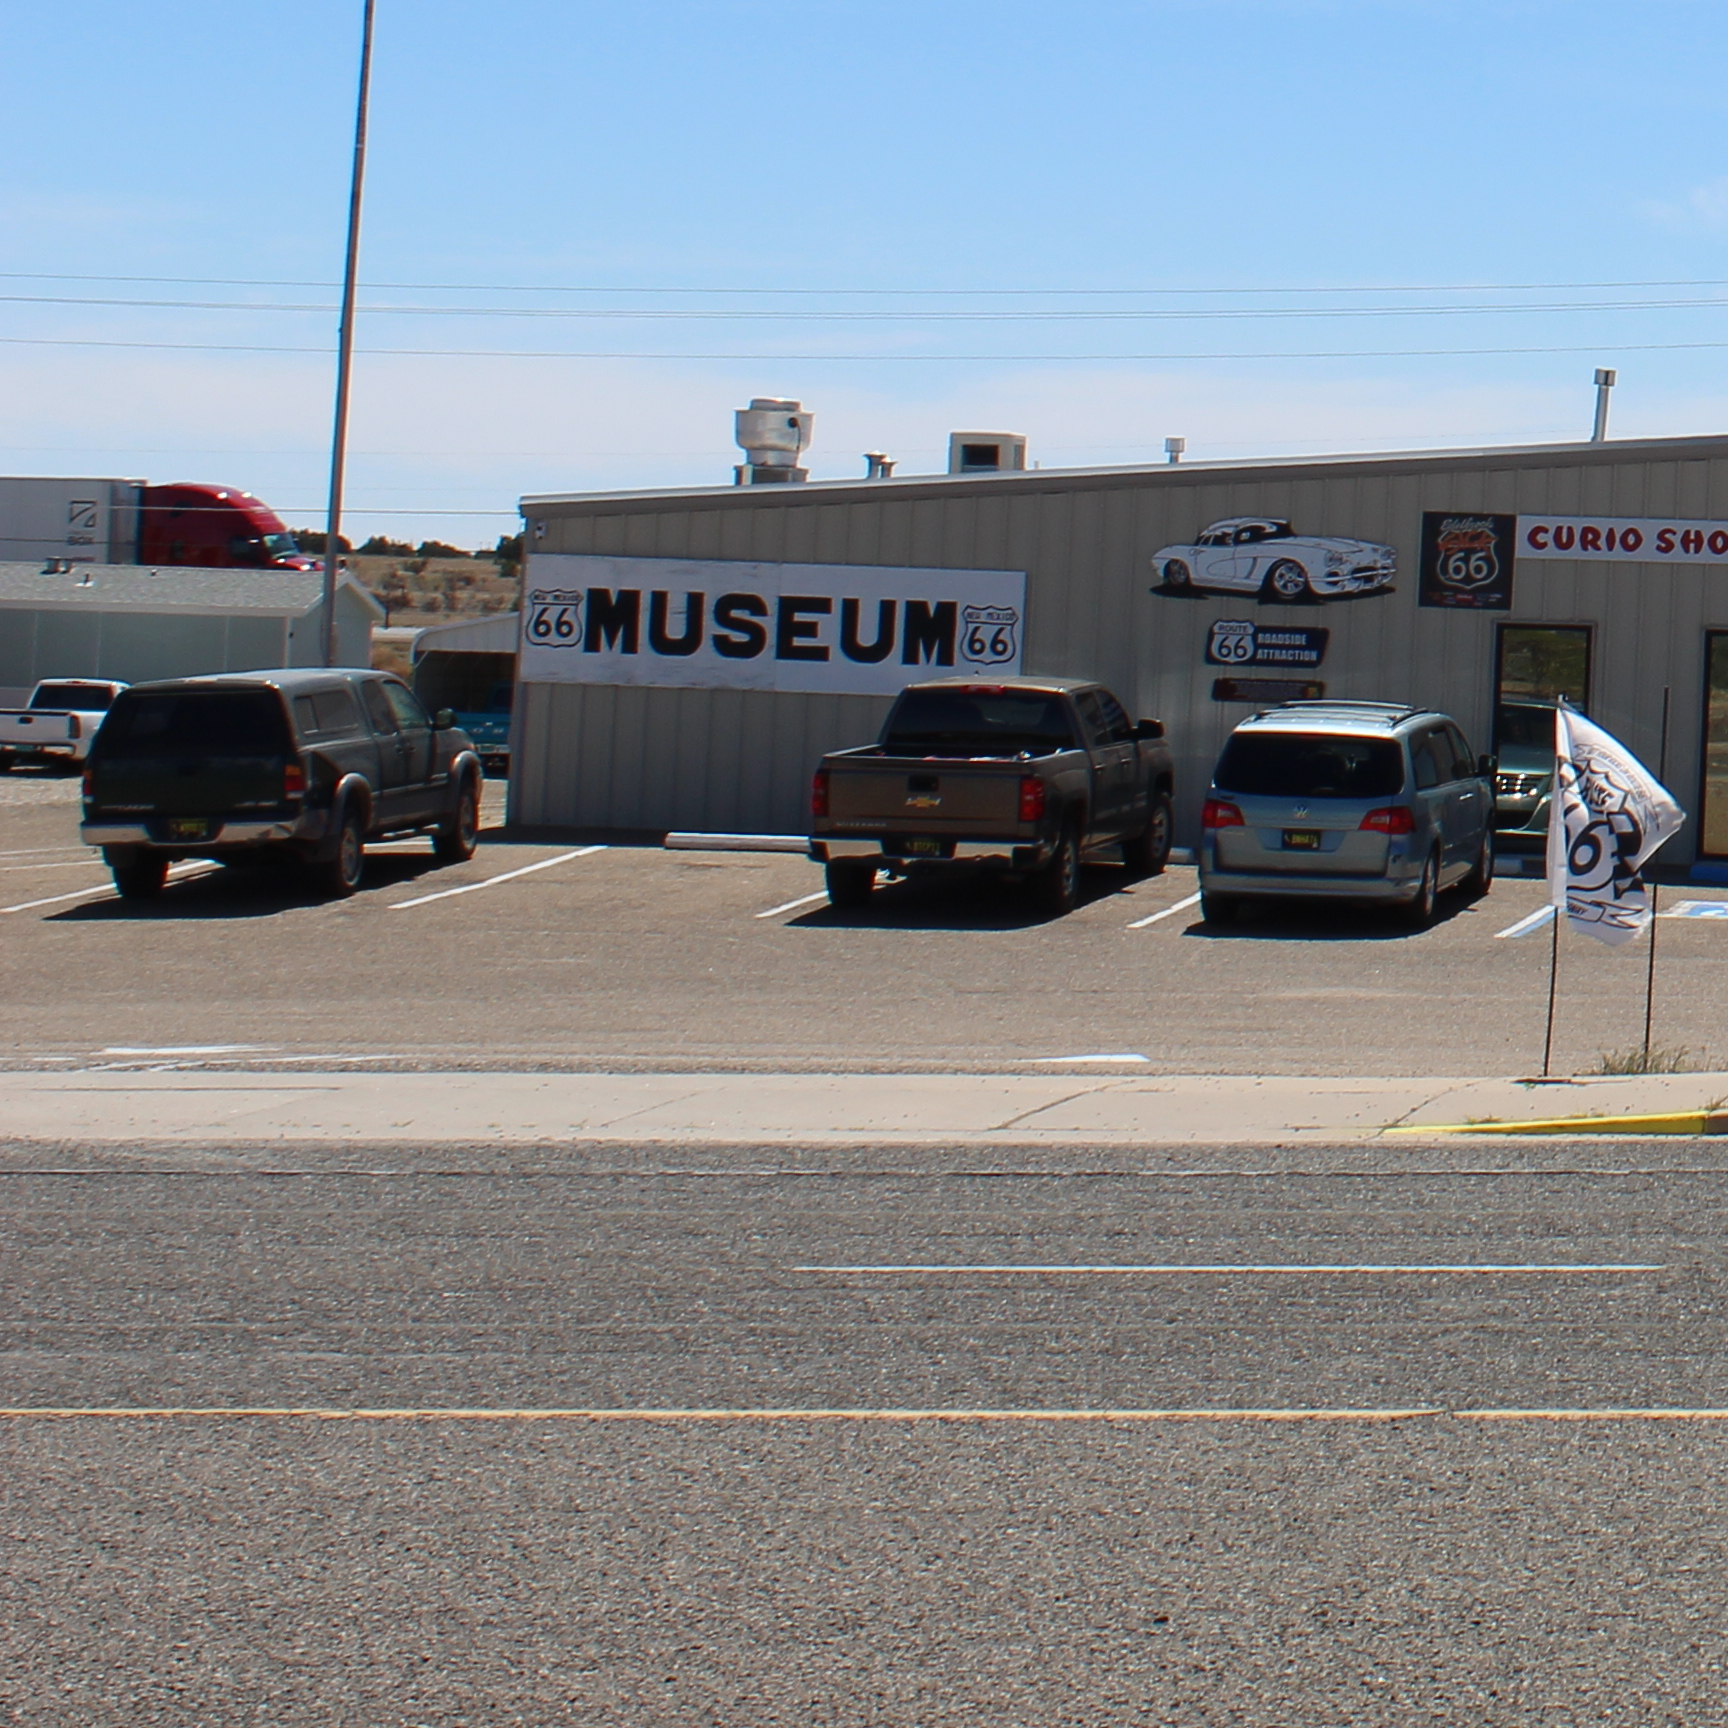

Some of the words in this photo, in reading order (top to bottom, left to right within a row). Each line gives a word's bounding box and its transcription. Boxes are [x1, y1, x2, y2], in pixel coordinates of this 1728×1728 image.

[1526, 525, 1644, 553] CURIO
[1448, 551, 1488, 580] 66
[533, 607, 574, 638] 66
[582, 587, 958, 667] MUSEUM
[966, 611, 981, 620] NEW
[986, 612, 1016, 622] MEXICO
[1218, 624, 1248, 633] ROUTE
[968, 625, 1009, 656] 66
[1218, 635, 1248, 659] 66
[1257, 633, 1307, 645] ROADSIDE
[1256, 649, 1318, 661] ATTRACTION
